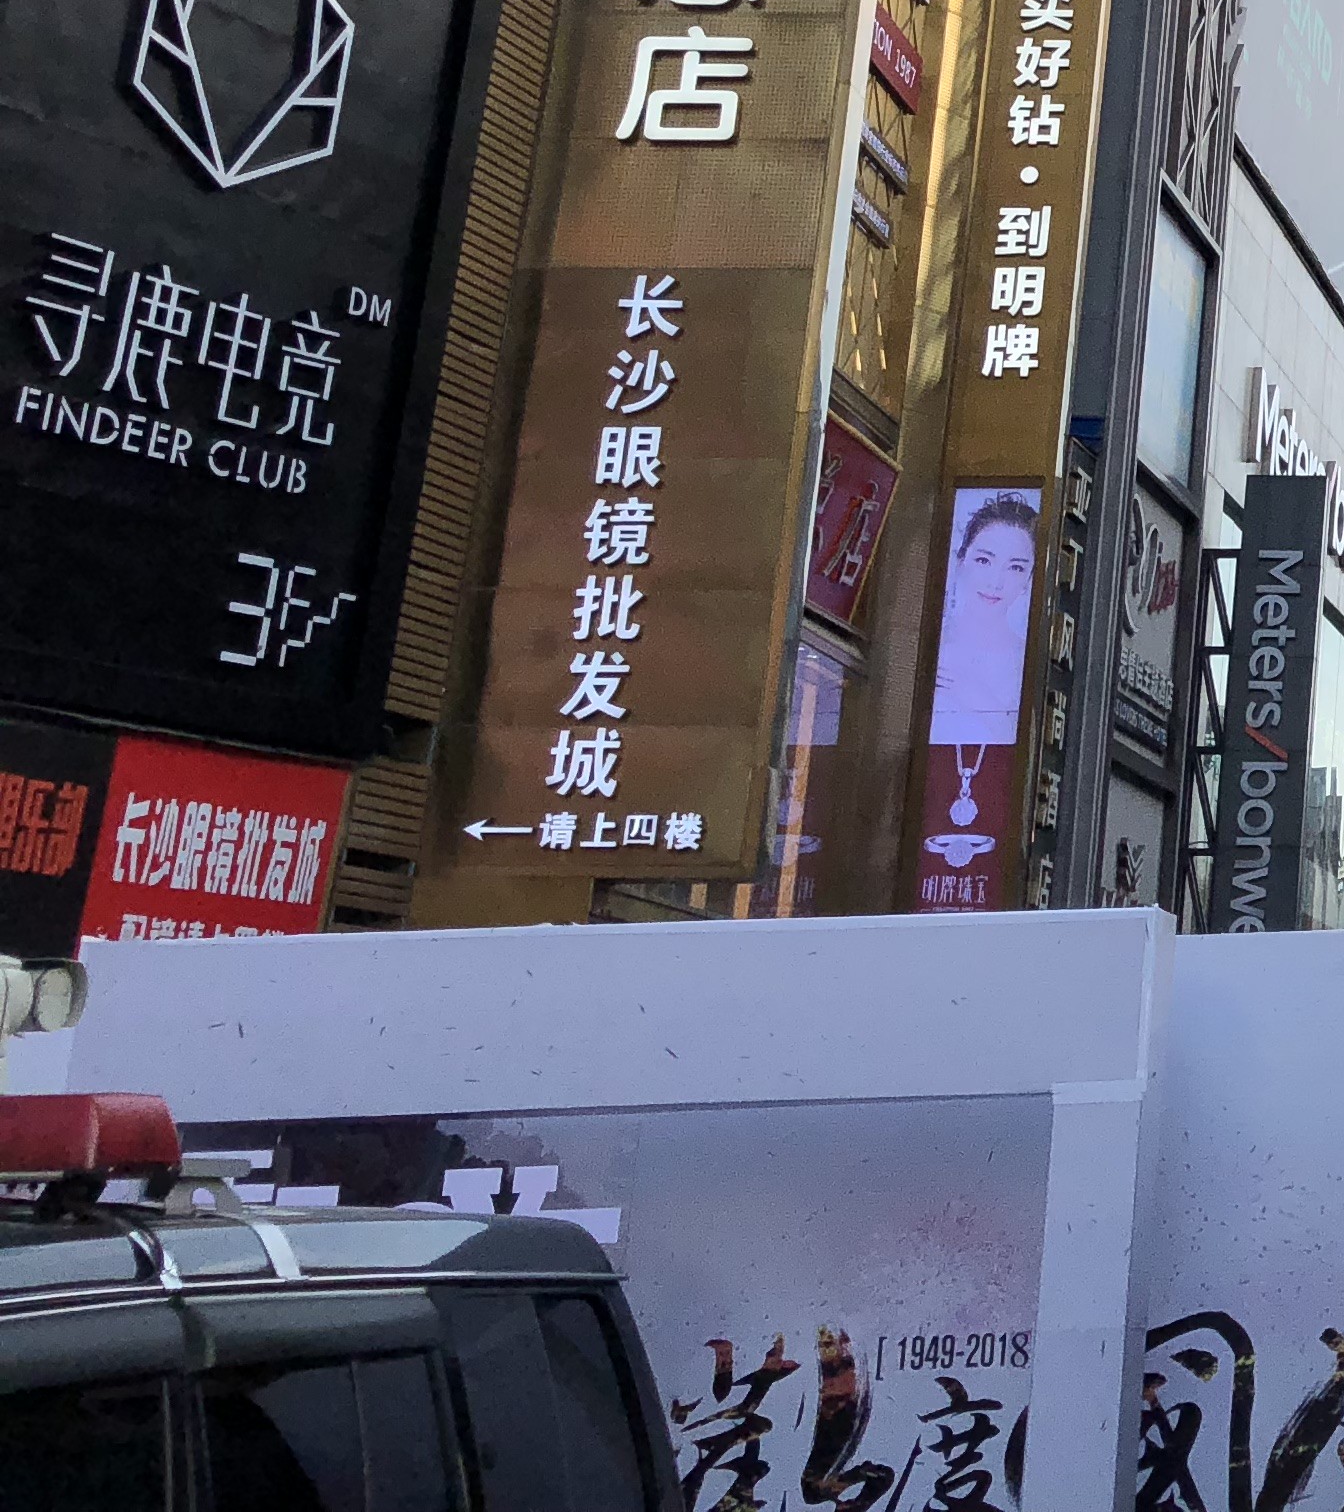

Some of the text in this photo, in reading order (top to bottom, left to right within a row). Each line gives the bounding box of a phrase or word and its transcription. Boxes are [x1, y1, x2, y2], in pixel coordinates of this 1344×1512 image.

[895, 48, 918, 88] 1987
[25, 232, 343, 446] 寻鹿电竞
[15, 386, 309, 495] FINDEER CLUB
[545, 274, 686, 799] 长沙眼镜批发城
[112, 792, 327, 905] 长沙眼镜批发城
[537, 811, 704, 855] 请上四楼
